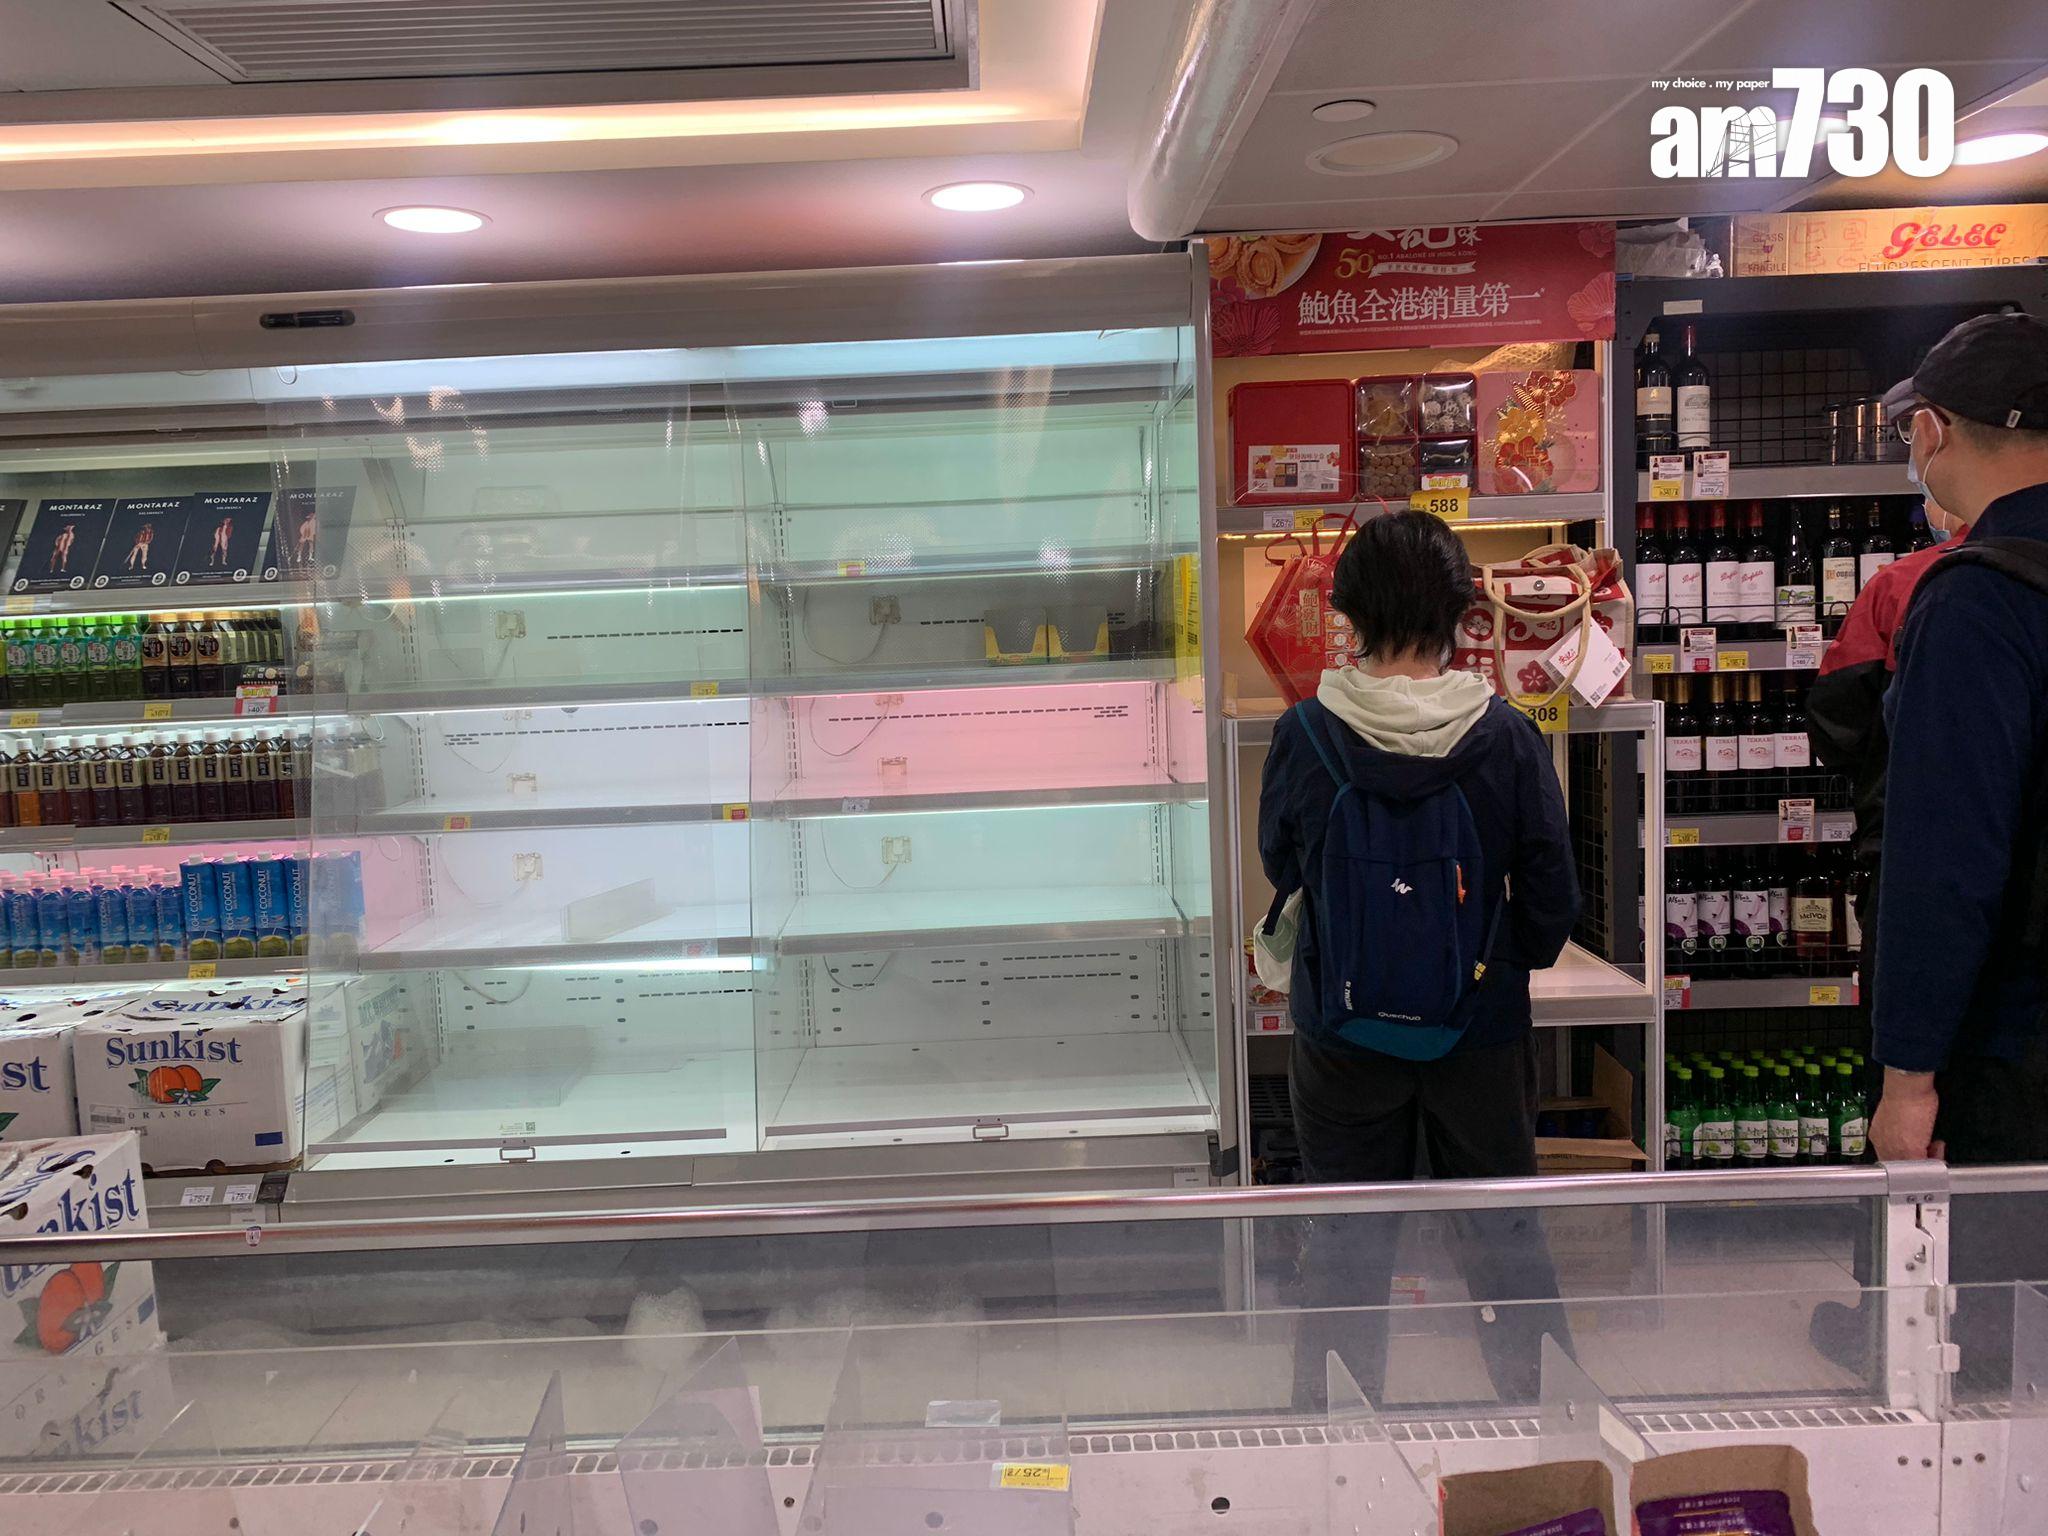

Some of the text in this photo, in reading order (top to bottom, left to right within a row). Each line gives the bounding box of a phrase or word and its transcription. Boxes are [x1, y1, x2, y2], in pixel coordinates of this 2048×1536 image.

[1752, 233, 1784, 243] GLASS
[1748, 262, 1788, 273] FRAGILE
[1298, 281, 1543, 326] 鮑魚全港銷量第一
[49, 503, 103, 511] MONTARAZ
[126, 501, 181, 510] MONTARAZ
[204, 496, 258, 504] MONTARAZ
[1430, 498, 1459, 513] 588
[1527, 706, 1558, 722] 308
[187, 872, 199, 912] COCONUT
[221, 872, 233, 912] COCONUT
[257, 869, 268, 910] COCONUT
[291, 868, 301, 908] COCONUT
[1378, 1011, 1422, 1021] Quechua
[106, 1030, 243, 1069] Sunkist
[128, 1107, 227, 1121] ORANGES
